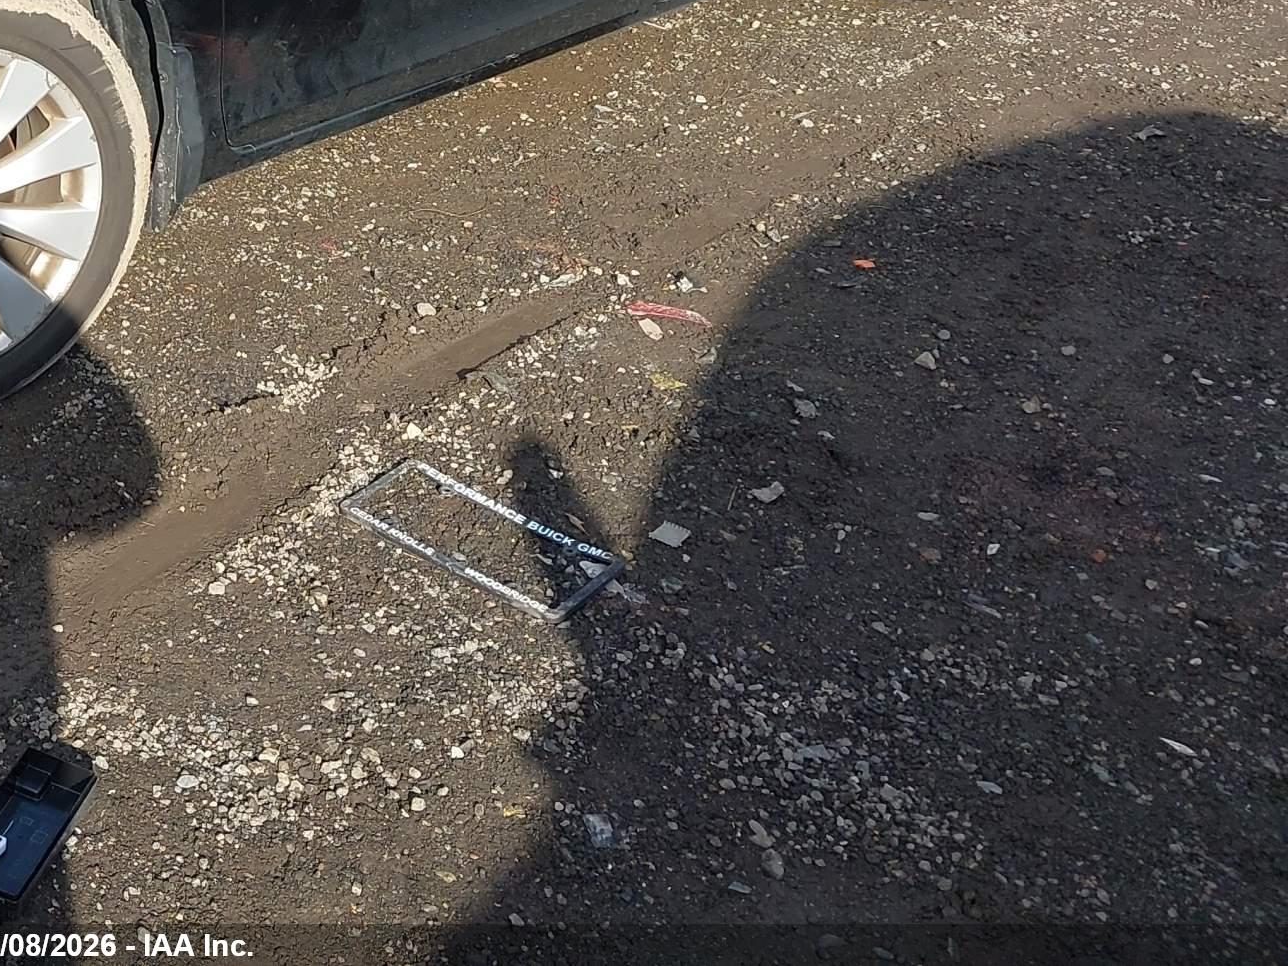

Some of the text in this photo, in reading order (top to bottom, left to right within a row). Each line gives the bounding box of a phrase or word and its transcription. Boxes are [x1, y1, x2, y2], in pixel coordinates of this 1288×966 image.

[350, 507, 436, 556] CEDAR KNOLLS
[416, 461, 614, 560] PERFORMANCE BUICK GMC
[464, 567, 549, 612] WOODBRIDGE
